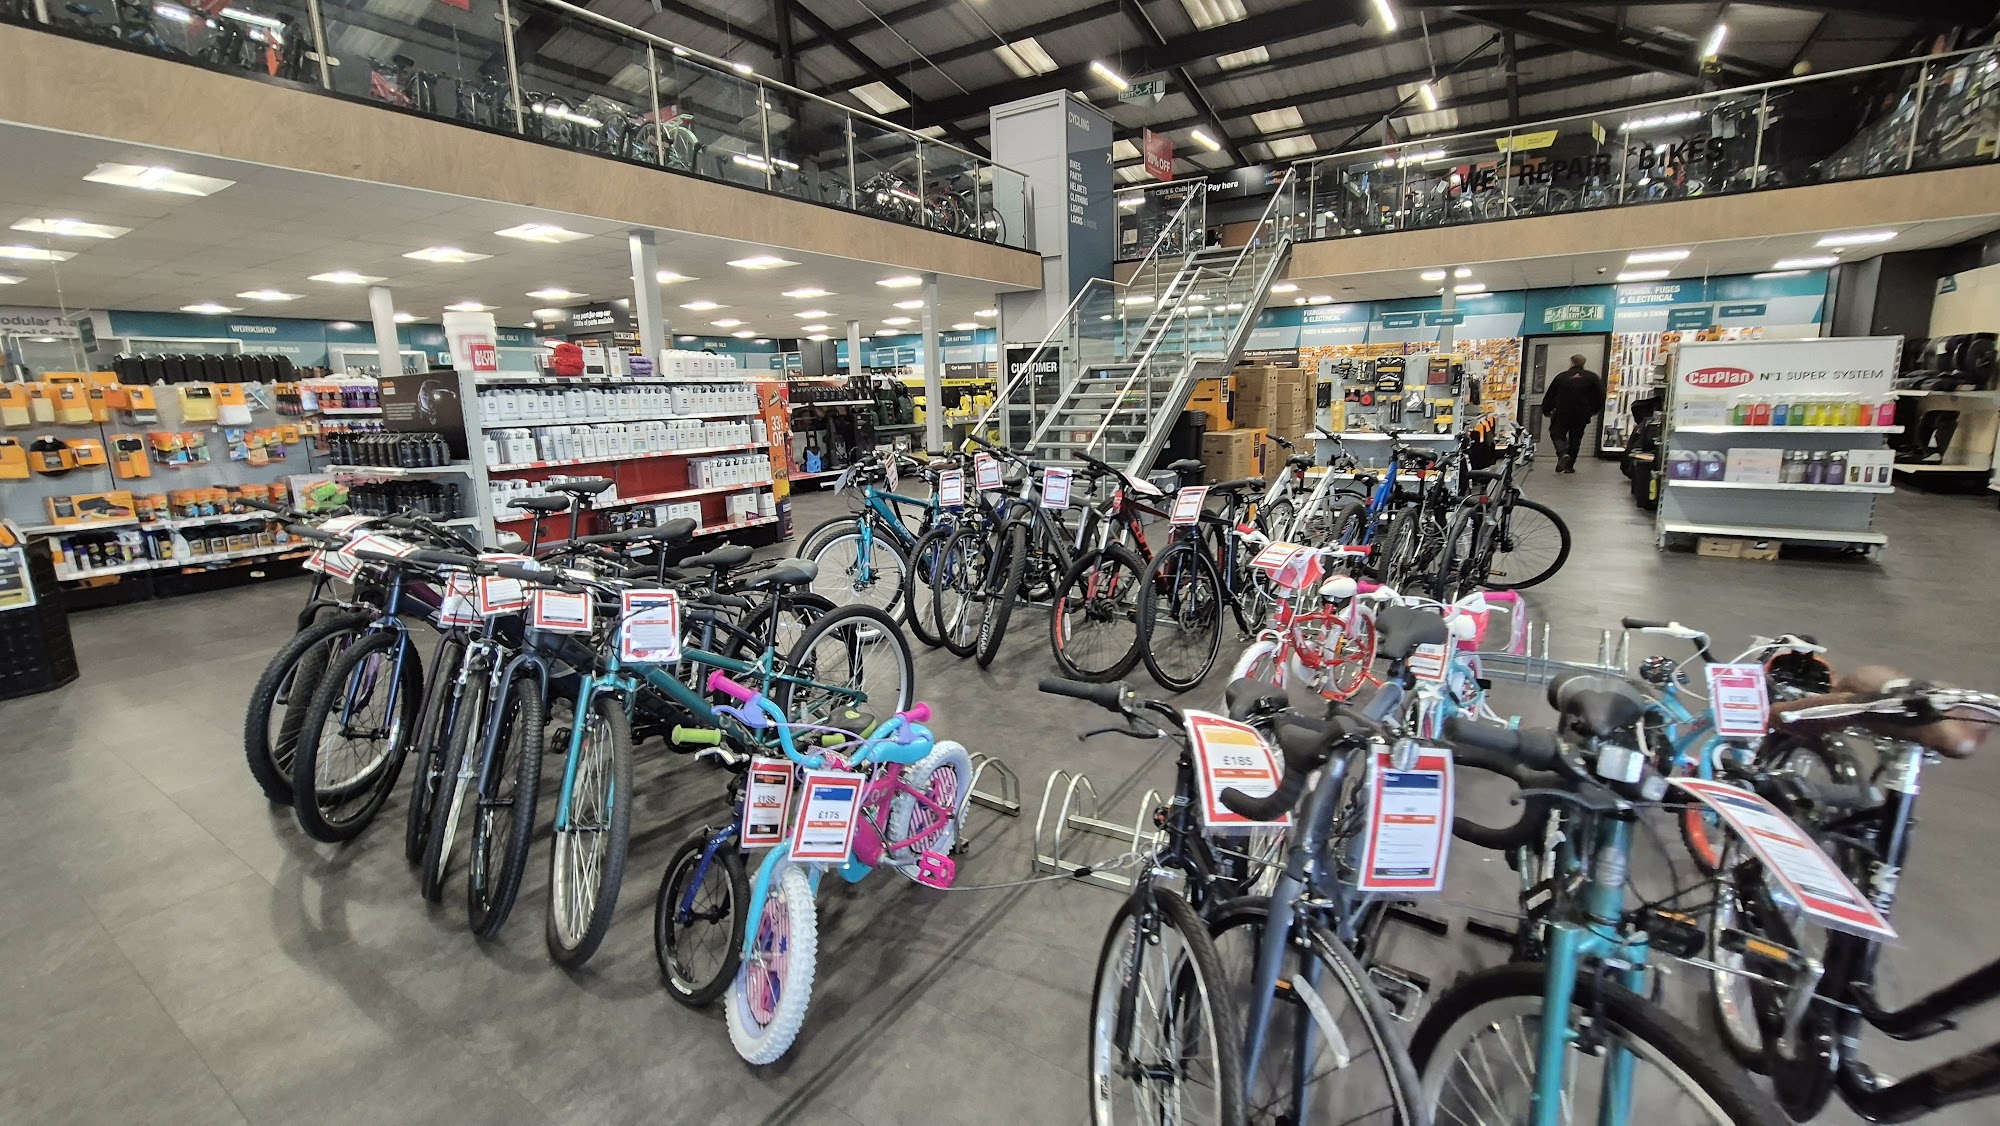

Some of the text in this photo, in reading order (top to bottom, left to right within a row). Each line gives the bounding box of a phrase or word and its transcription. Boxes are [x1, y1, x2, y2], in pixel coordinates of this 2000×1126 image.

[1068, 111, 1090, 131] CYCLING
[1069, 159, 1082, 171] BIKES
[1160, 159, 1171, 173] OFF
[1460, 137, 1725, 193] WE REPAIR BIKES
[1069, 170, 1083, 183] PARTS
[1069, 181, 1088, 195] HELMETS
[1156, 188, 1169, 196] Click
[1207, 180, 1239, 192] Pay here
[1069, 192, 1089, 207] CLOTHING
[1070, 204, 1084, 216] LIGHTS
[1070, 214, 1084, 226] LOCKS
[1654, 285, 1681, 294] FUSES
[1627, 293, 1675, 304] ELECTRICAL
[0, 316, 49, 326] odular
[1309, 314, 1341, 323] ELECTRICAL
[231, 324, 277, 335] WORKSHOP
[1687, 371, 1751, 385] CarPlan
[1786, 371, 1827, 381] SUPER
[1832, 369, 1885, 380] SYSTEM
[818, 810, 840, 820] £175
